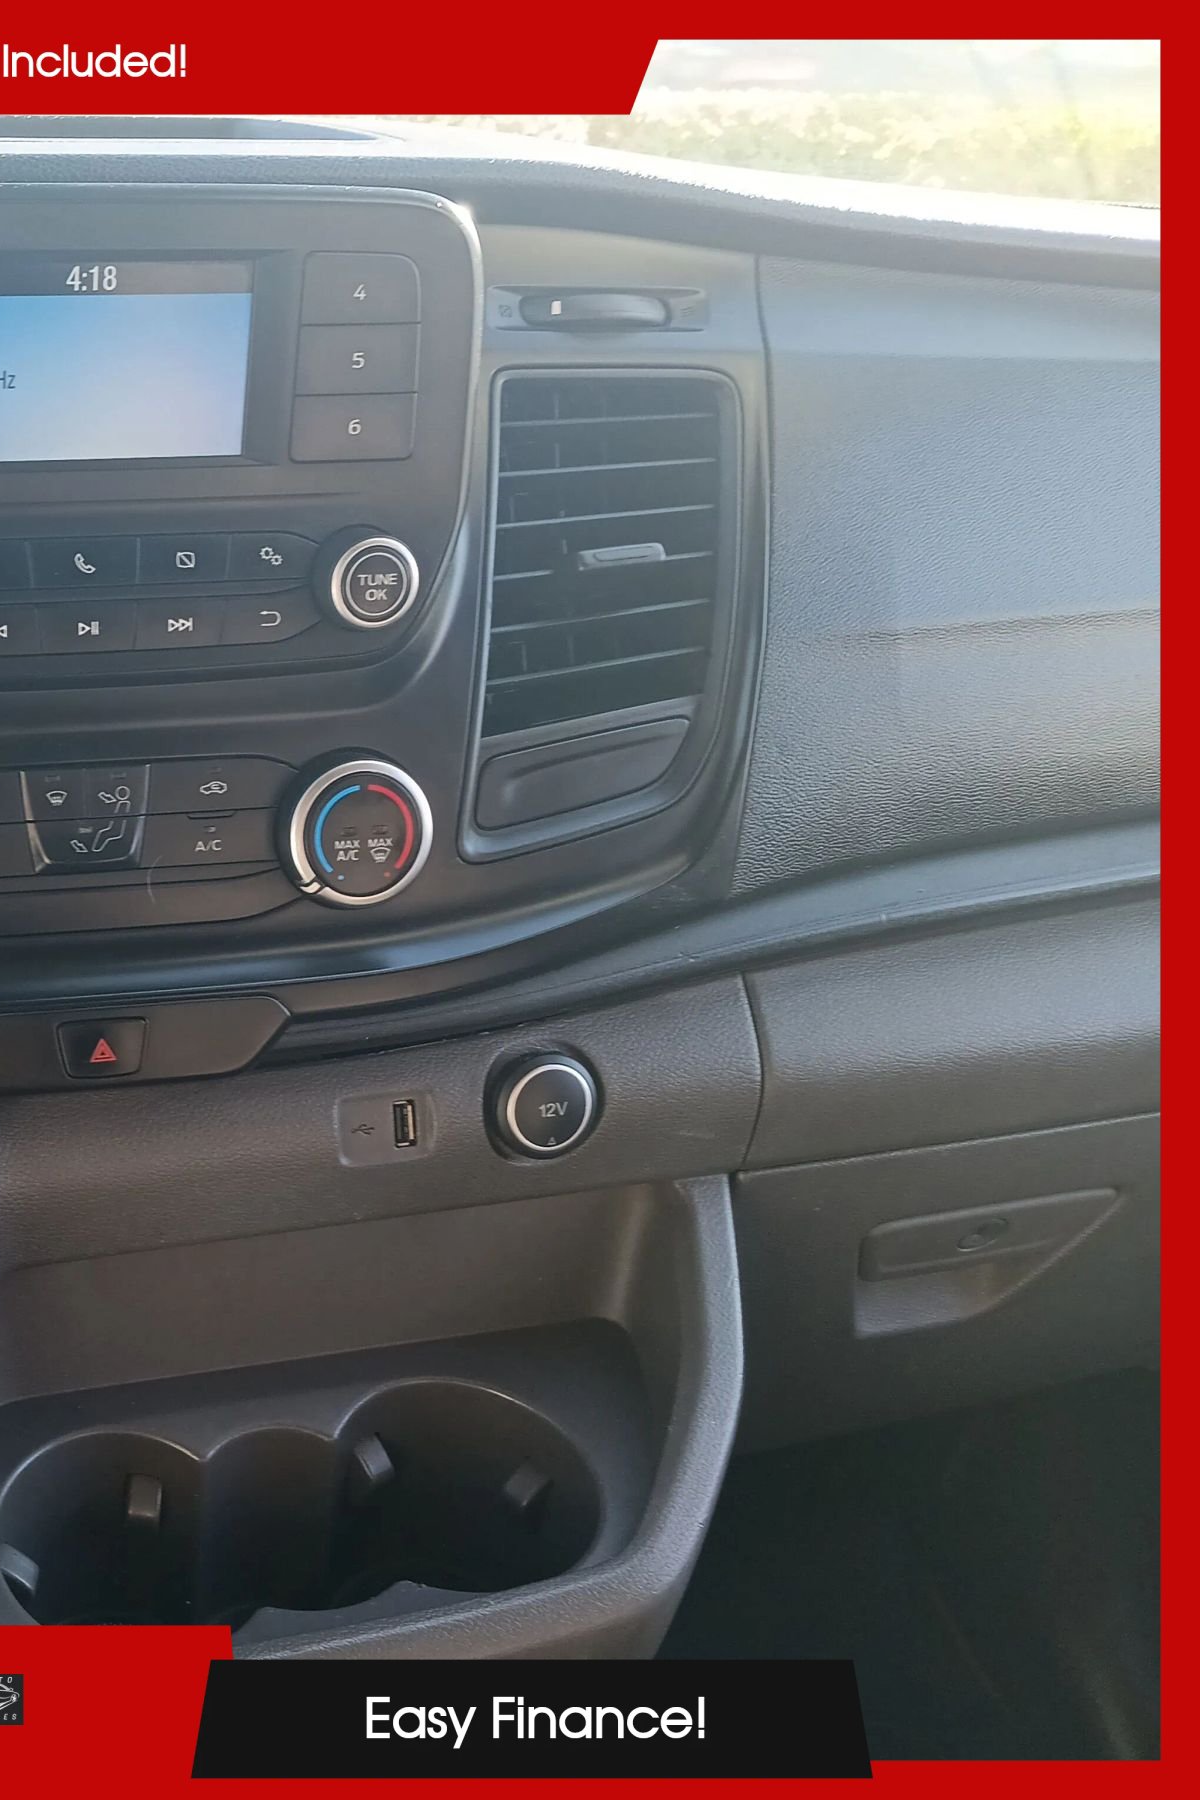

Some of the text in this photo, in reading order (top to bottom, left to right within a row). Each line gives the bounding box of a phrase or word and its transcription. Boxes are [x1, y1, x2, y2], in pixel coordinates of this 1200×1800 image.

[66, 265, 118, 292] 4:18
[352, 284, 367, 300] 4
[352, 353, 365, 370] 5
[347, 419, 361, 436] 6
[356, 573, 399, 586] TUNE
[365, 588, 388, 601] OK
[194, 839, 222, 852] A/C
[334, 839, 360, 849] MAX
[367, 838, 393, 848] MAX
[336, 849, 360, 861] A/C
[538, 1101, 567, 1118] 12V
